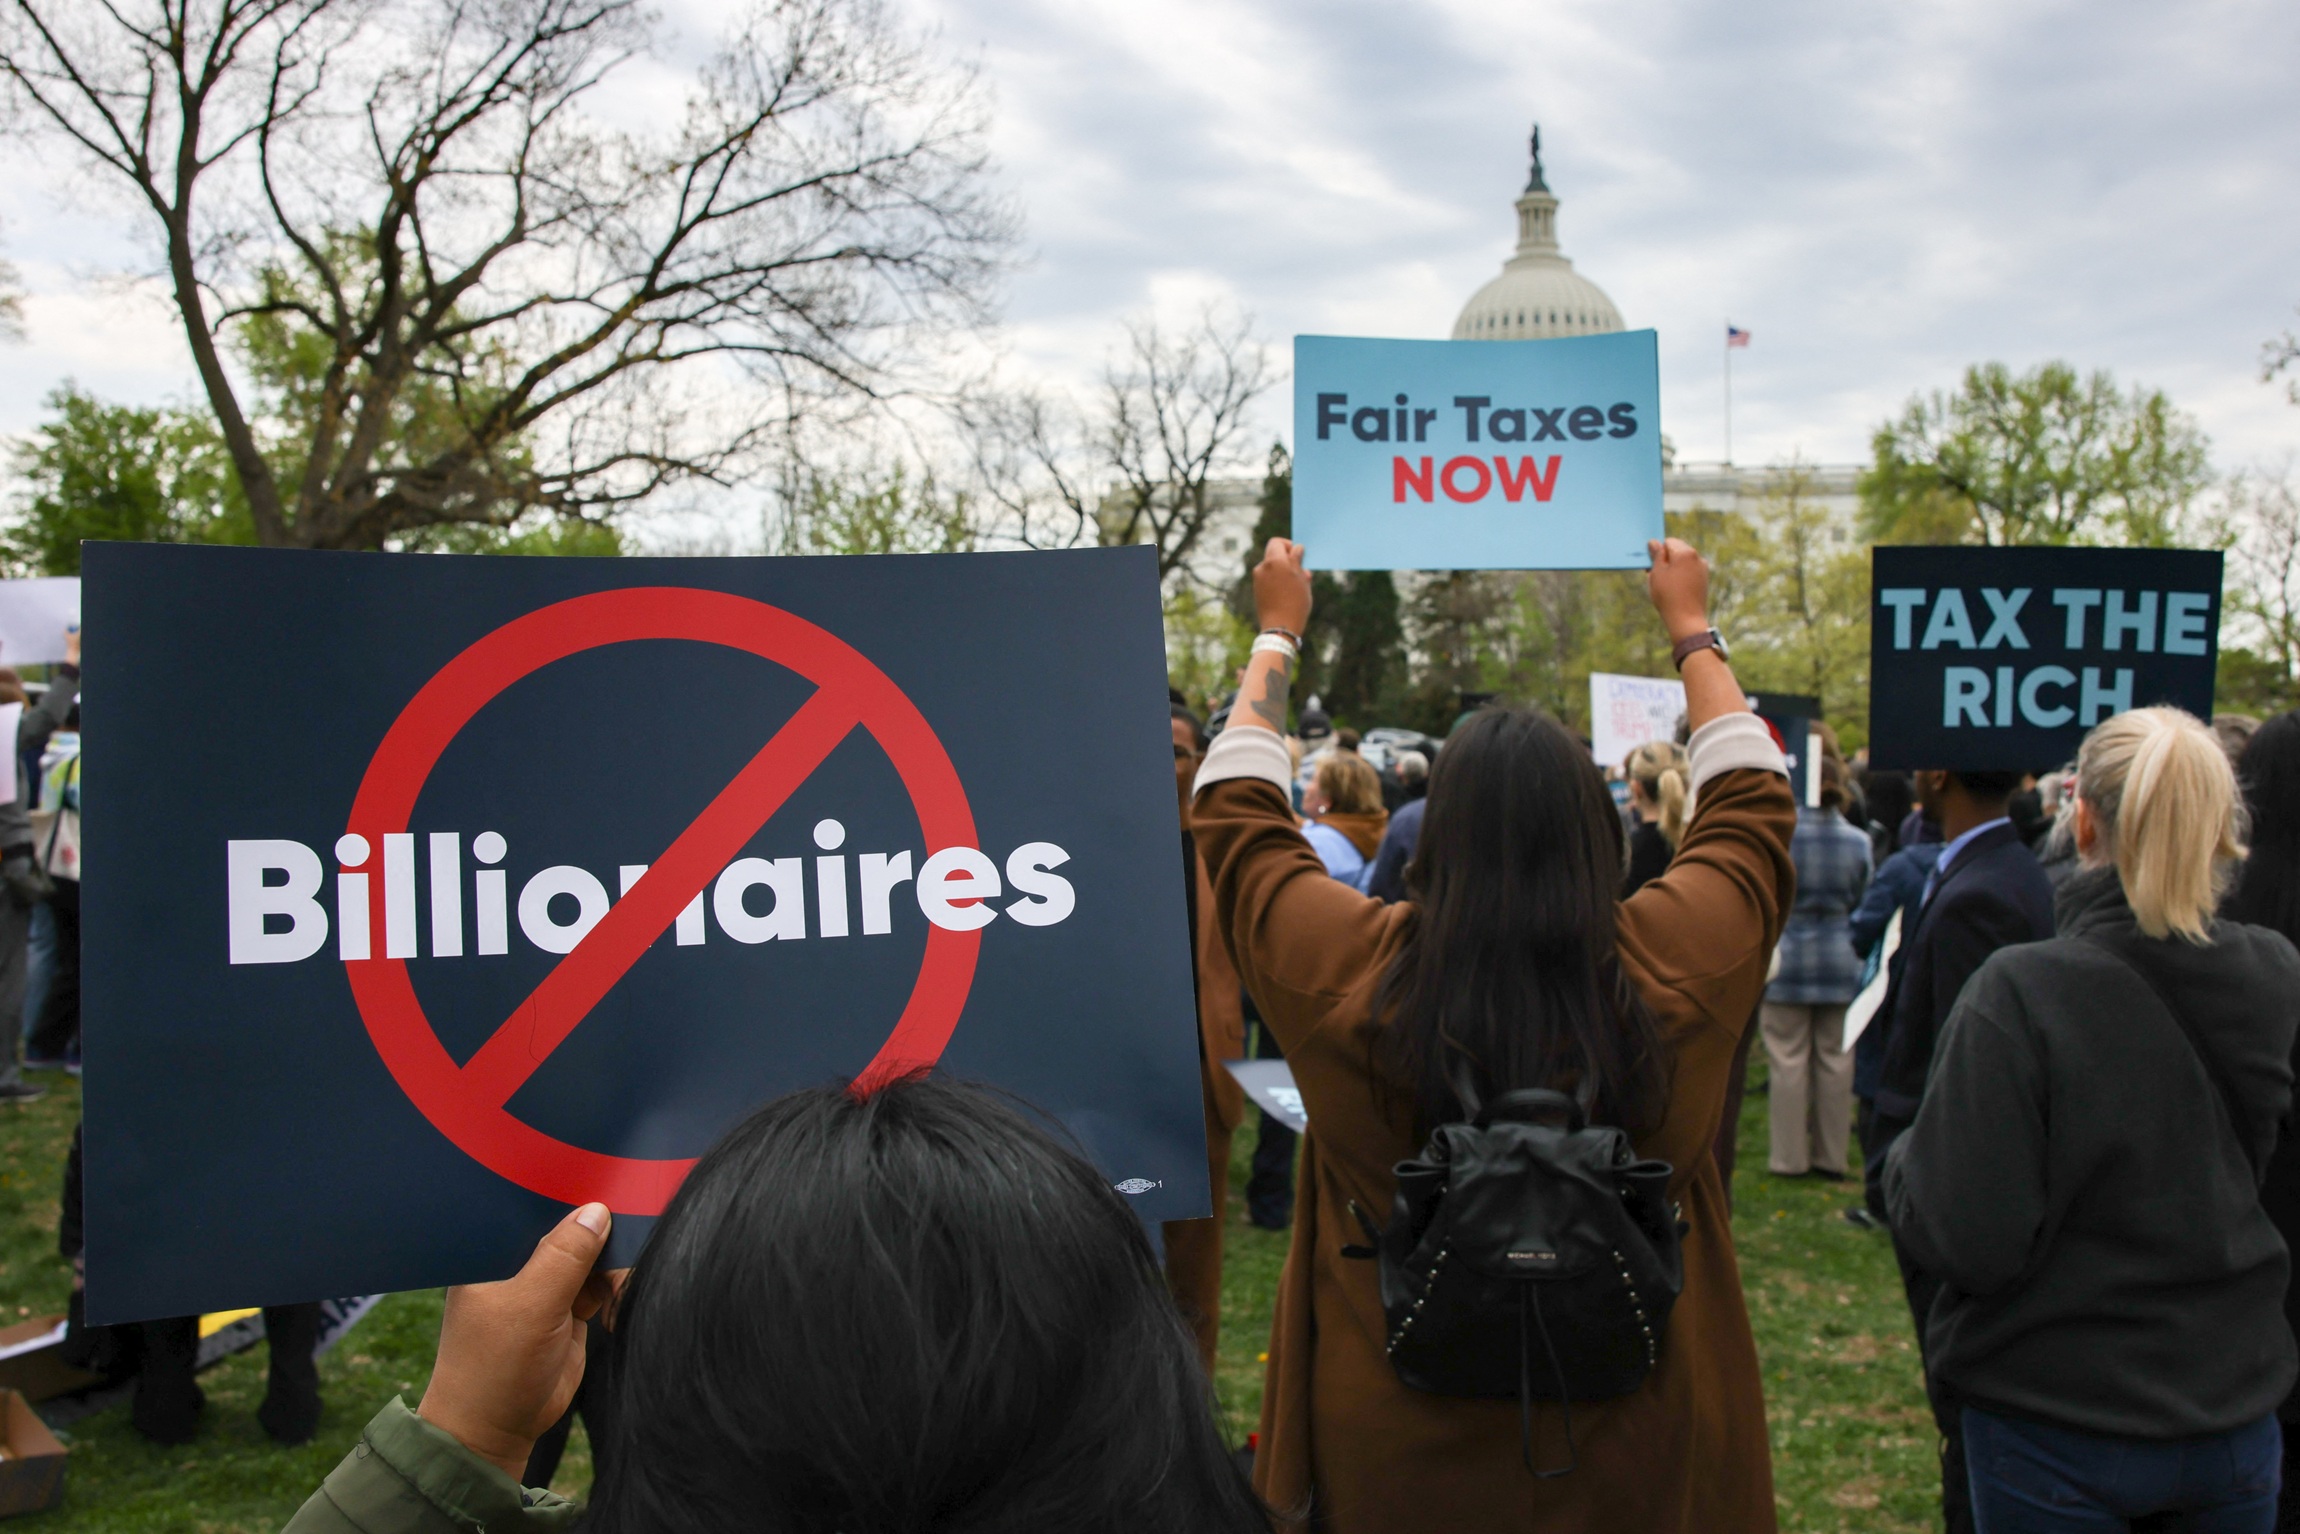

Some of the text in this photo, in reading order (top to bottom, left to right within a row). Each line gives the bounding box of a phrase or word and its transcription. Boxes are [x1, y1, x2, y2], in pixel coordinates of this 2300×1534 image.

[1316, 391, 1639, 443] Fair Taxes
[1392, 455, 1562, 504] NOW
[1880, 587, 2211, 656] TAX THE
[1942, 664, 2135, 728] RICH
